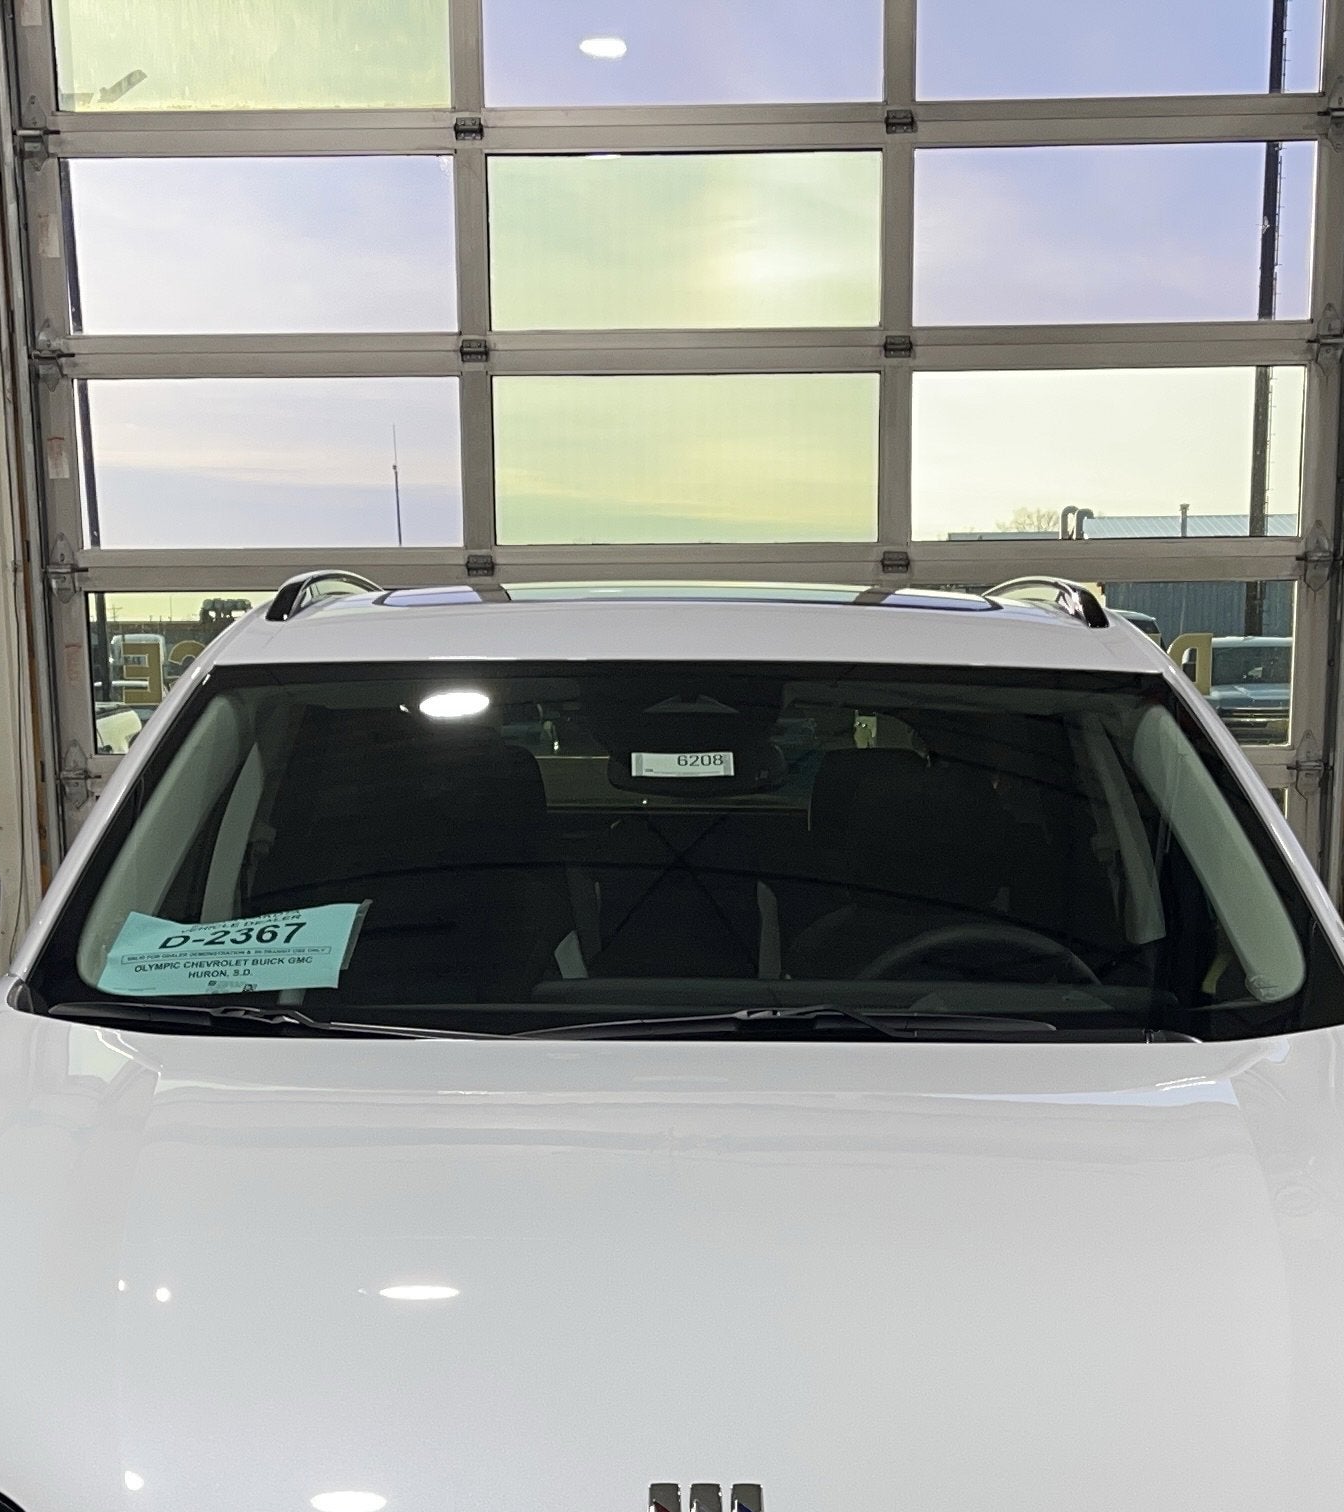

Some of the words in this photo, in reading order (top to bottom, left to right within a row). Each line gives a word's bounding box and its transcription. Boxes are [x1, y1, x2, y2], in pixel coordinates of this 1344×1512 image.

[677, 754, 724, 767] 6208
[158, 922, 307, 949] D-2367
[134, 961, 181, 973] OLYMPIC
[183, 958, 250, 969] CHEVROLET
[251, 957, 285, 966] BUICK
[288, 956, 313, 964] GMC
